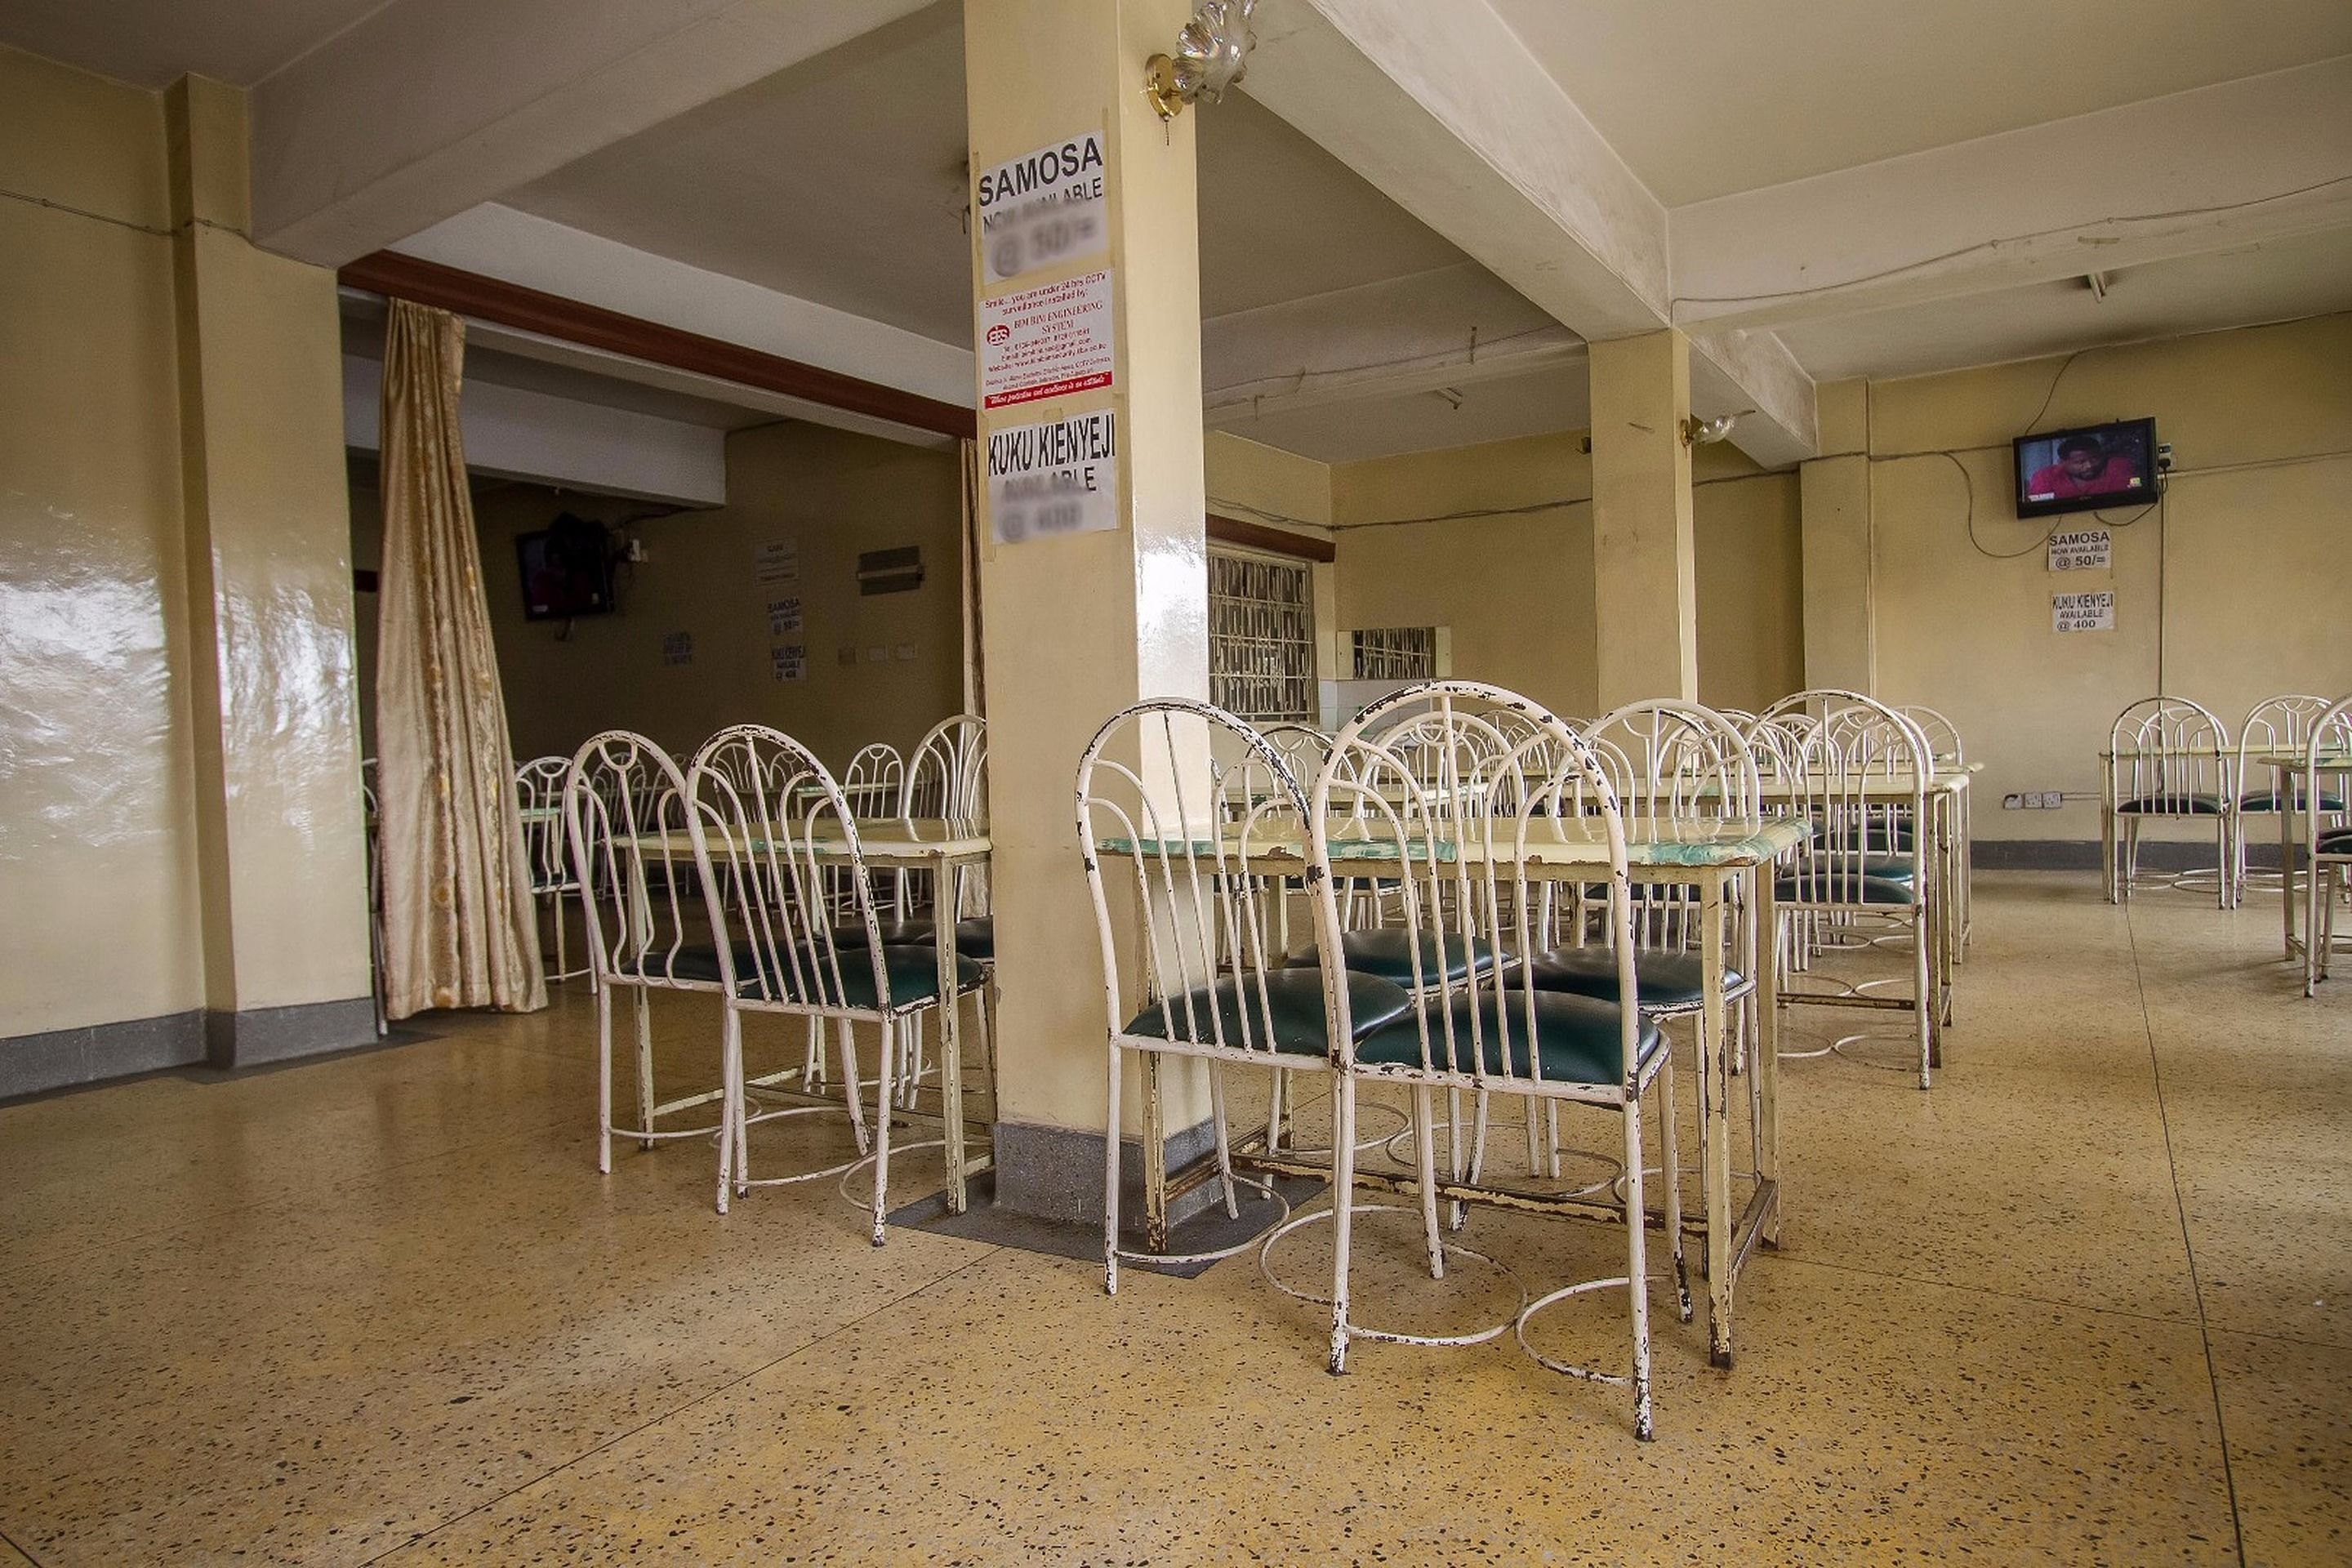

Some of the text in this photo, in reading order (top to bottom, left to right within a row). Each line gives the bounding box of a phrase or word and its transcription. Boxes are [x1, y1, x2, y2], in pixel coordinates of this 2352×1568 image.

[979, 137, 1103, 207] SAMOSA
[988, 413, 1116, 477] KUKU KIENYEJI
[2049, 531, 2110, 547] SAMOSA
[2075, 554, 2106, 566] 50/=
[2059, 609, 2104, 619] AVAILABLE
[2074, 620, 2096, 629] 400
